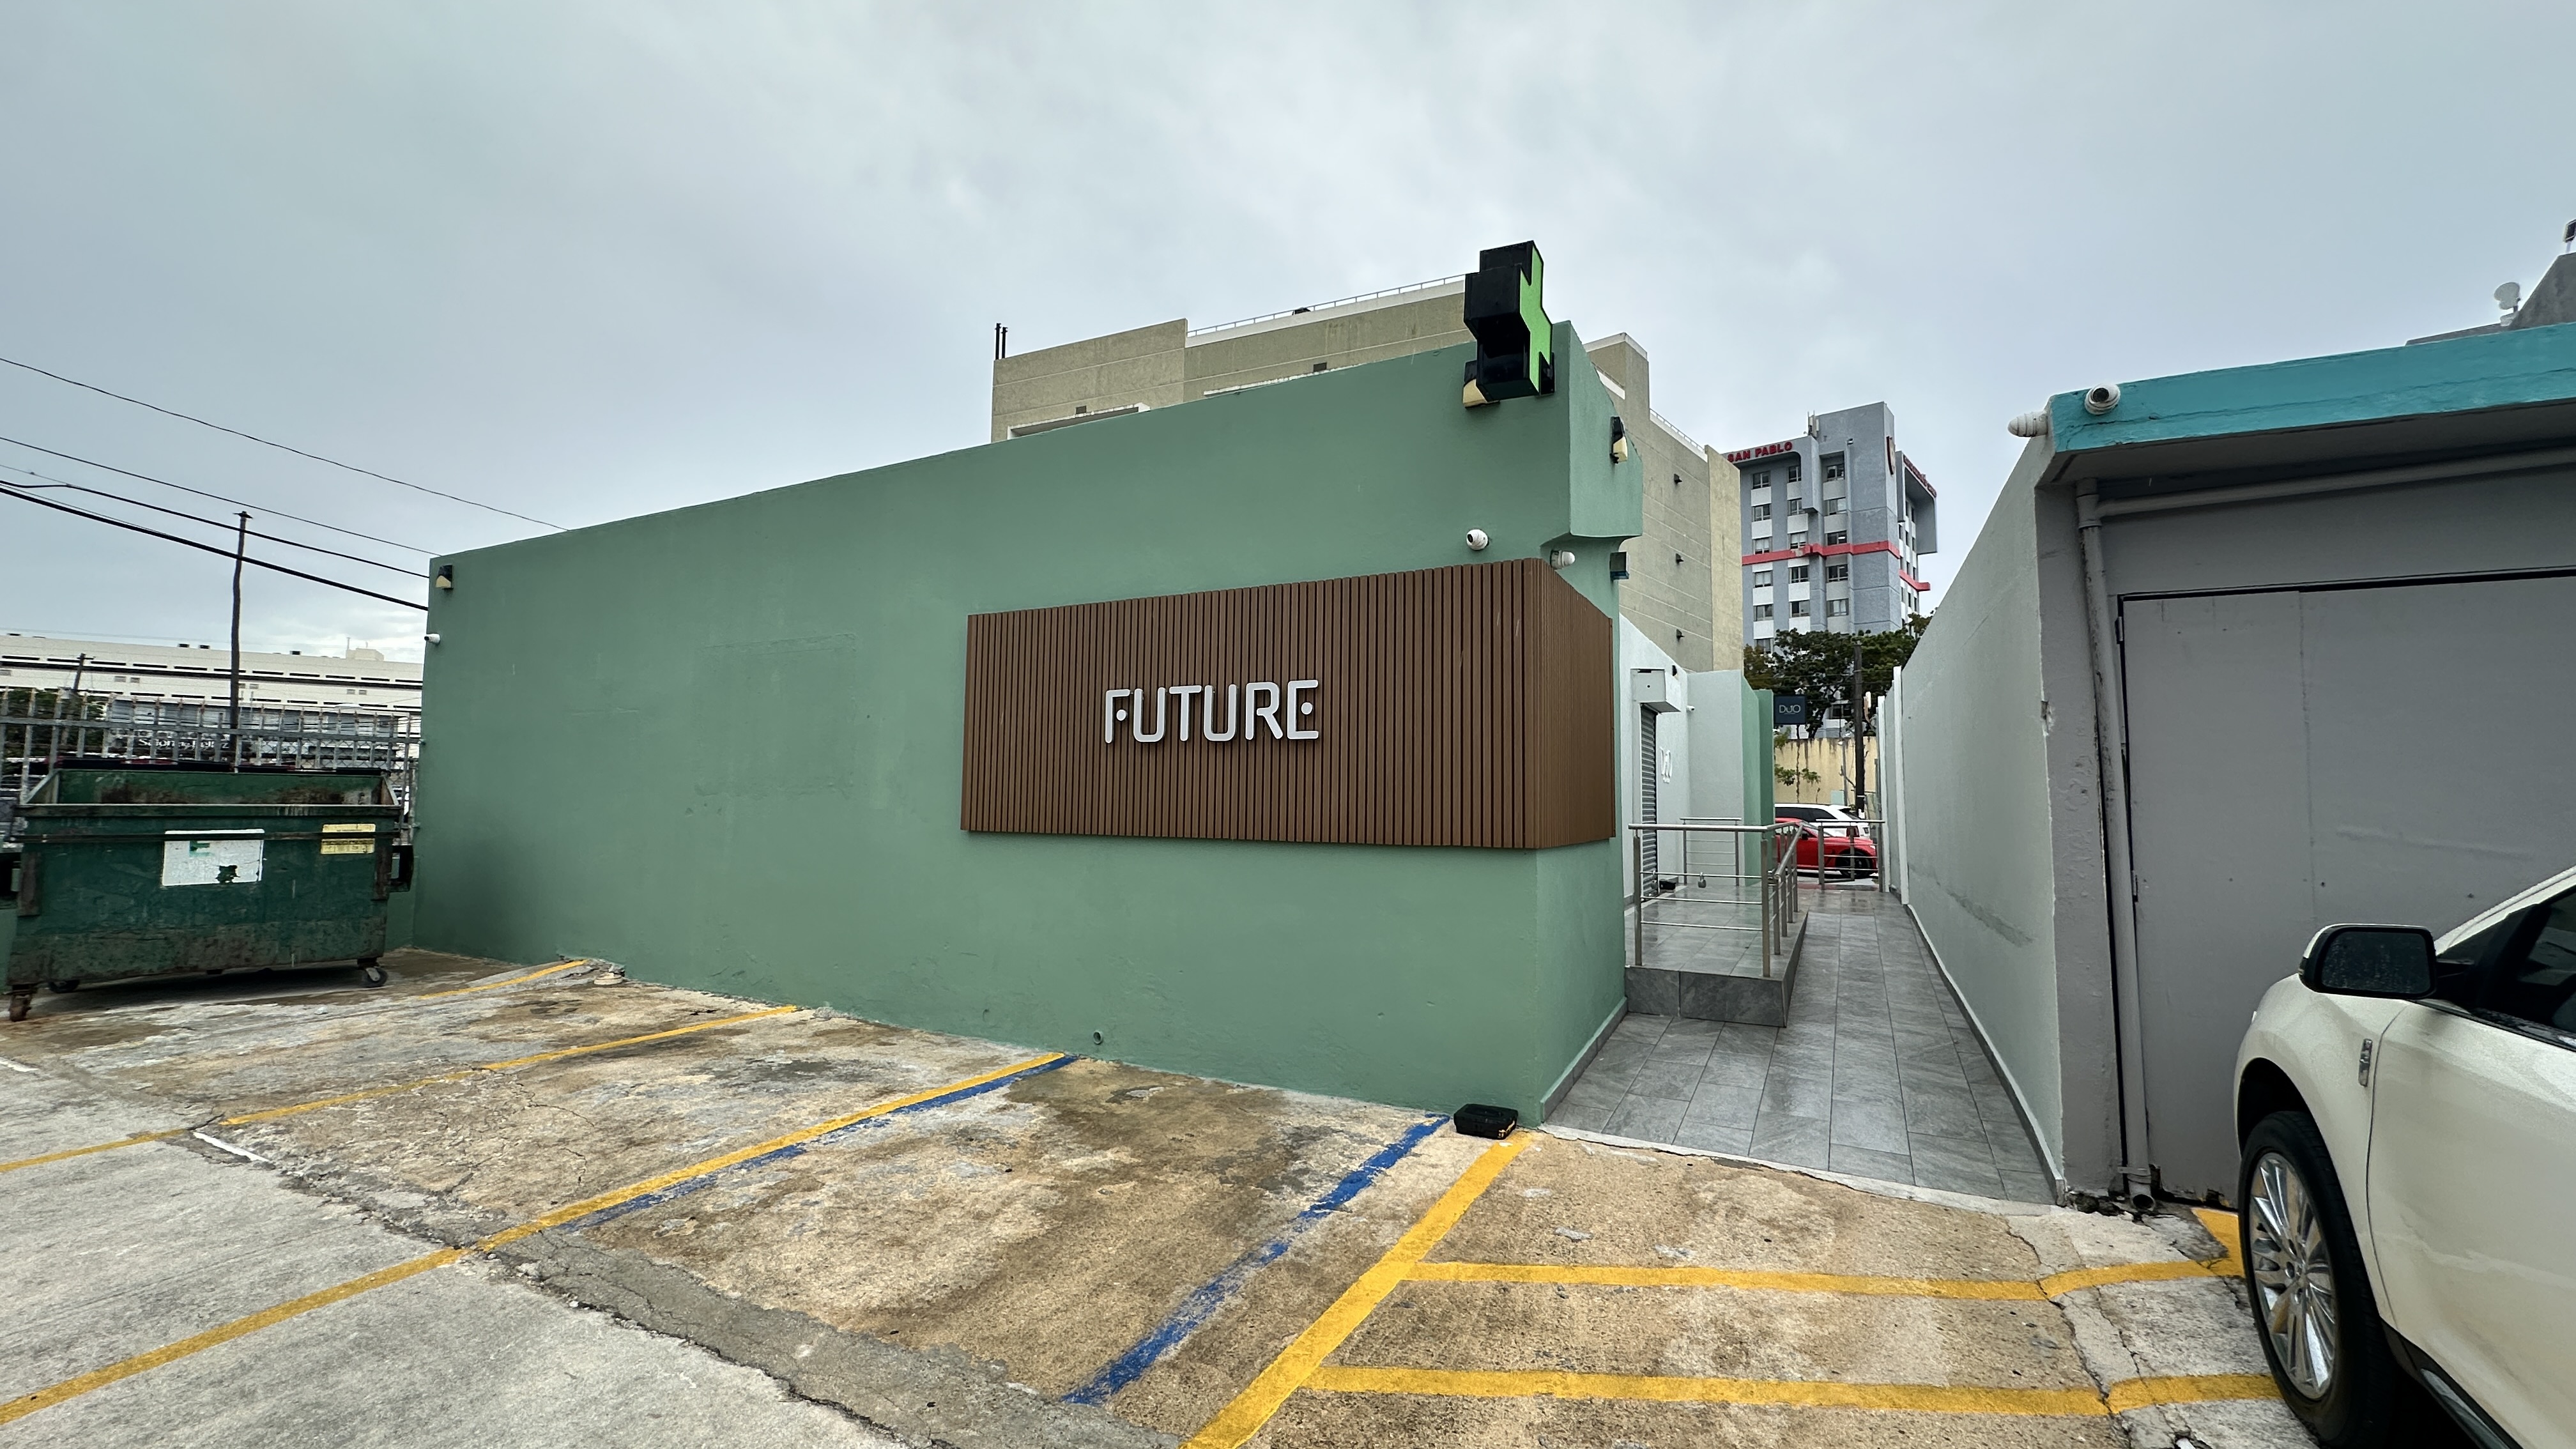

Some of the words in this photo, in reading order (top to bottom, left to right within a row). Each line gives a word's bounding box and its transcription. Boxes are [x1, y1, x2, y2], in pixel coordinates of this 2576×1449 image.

[1727, 450, 1750, 462] SAN
[1755, 441, 1792, 457] PABLO
[1105, 679, 1319, 744] FUTURE
